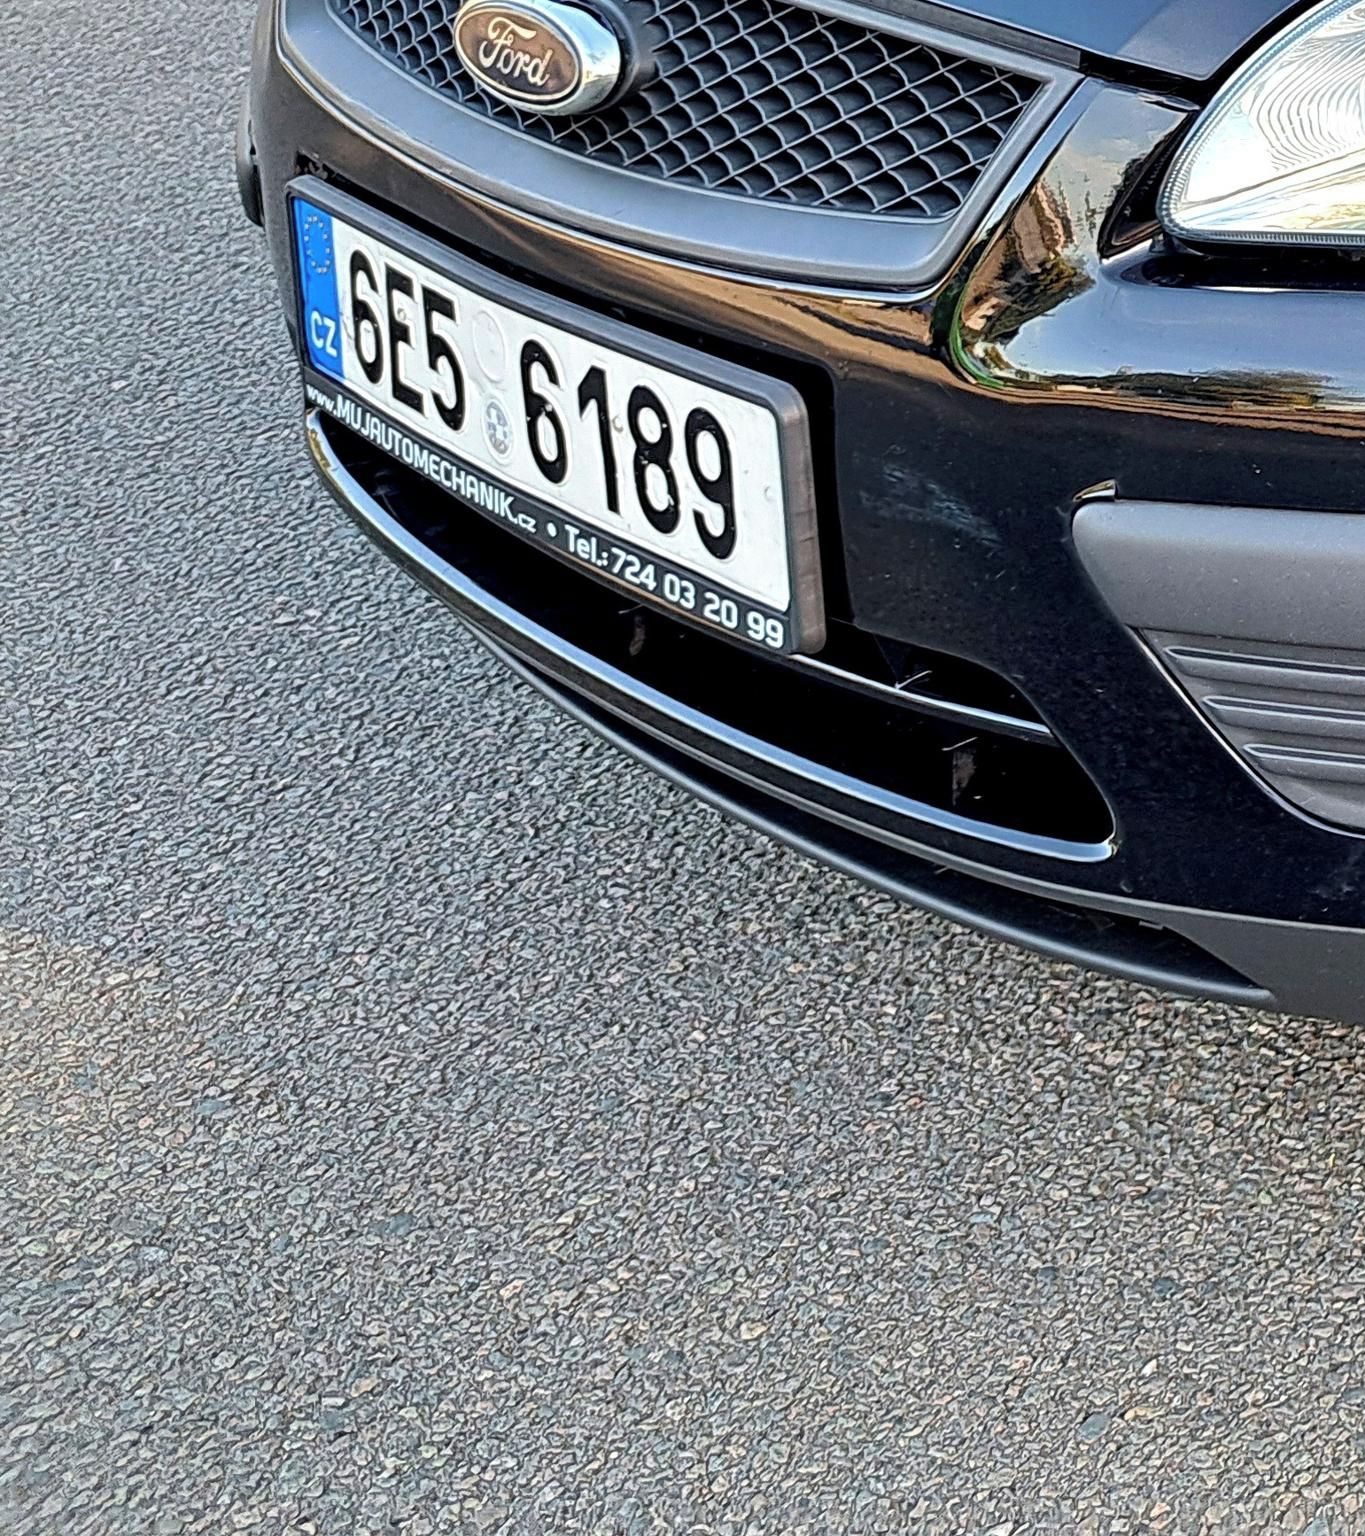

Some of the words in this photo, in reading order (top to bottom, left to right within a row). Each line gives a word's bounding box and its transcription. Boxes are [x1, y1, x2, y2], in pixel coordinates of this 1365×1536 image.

[478, 16, 554, 86] Ford
[310, 310, 338, 357] CZ
[350, 249, 465, 432] 6E5
[521, 339, 737, 560] 6189
[306, 383, 537, 533] www.MUJAUTOMECHANIK.cz
[664, 573, 695, 611] 03
[704, 591, 738, 630] 20
[747, 611, 785, 649] 99
